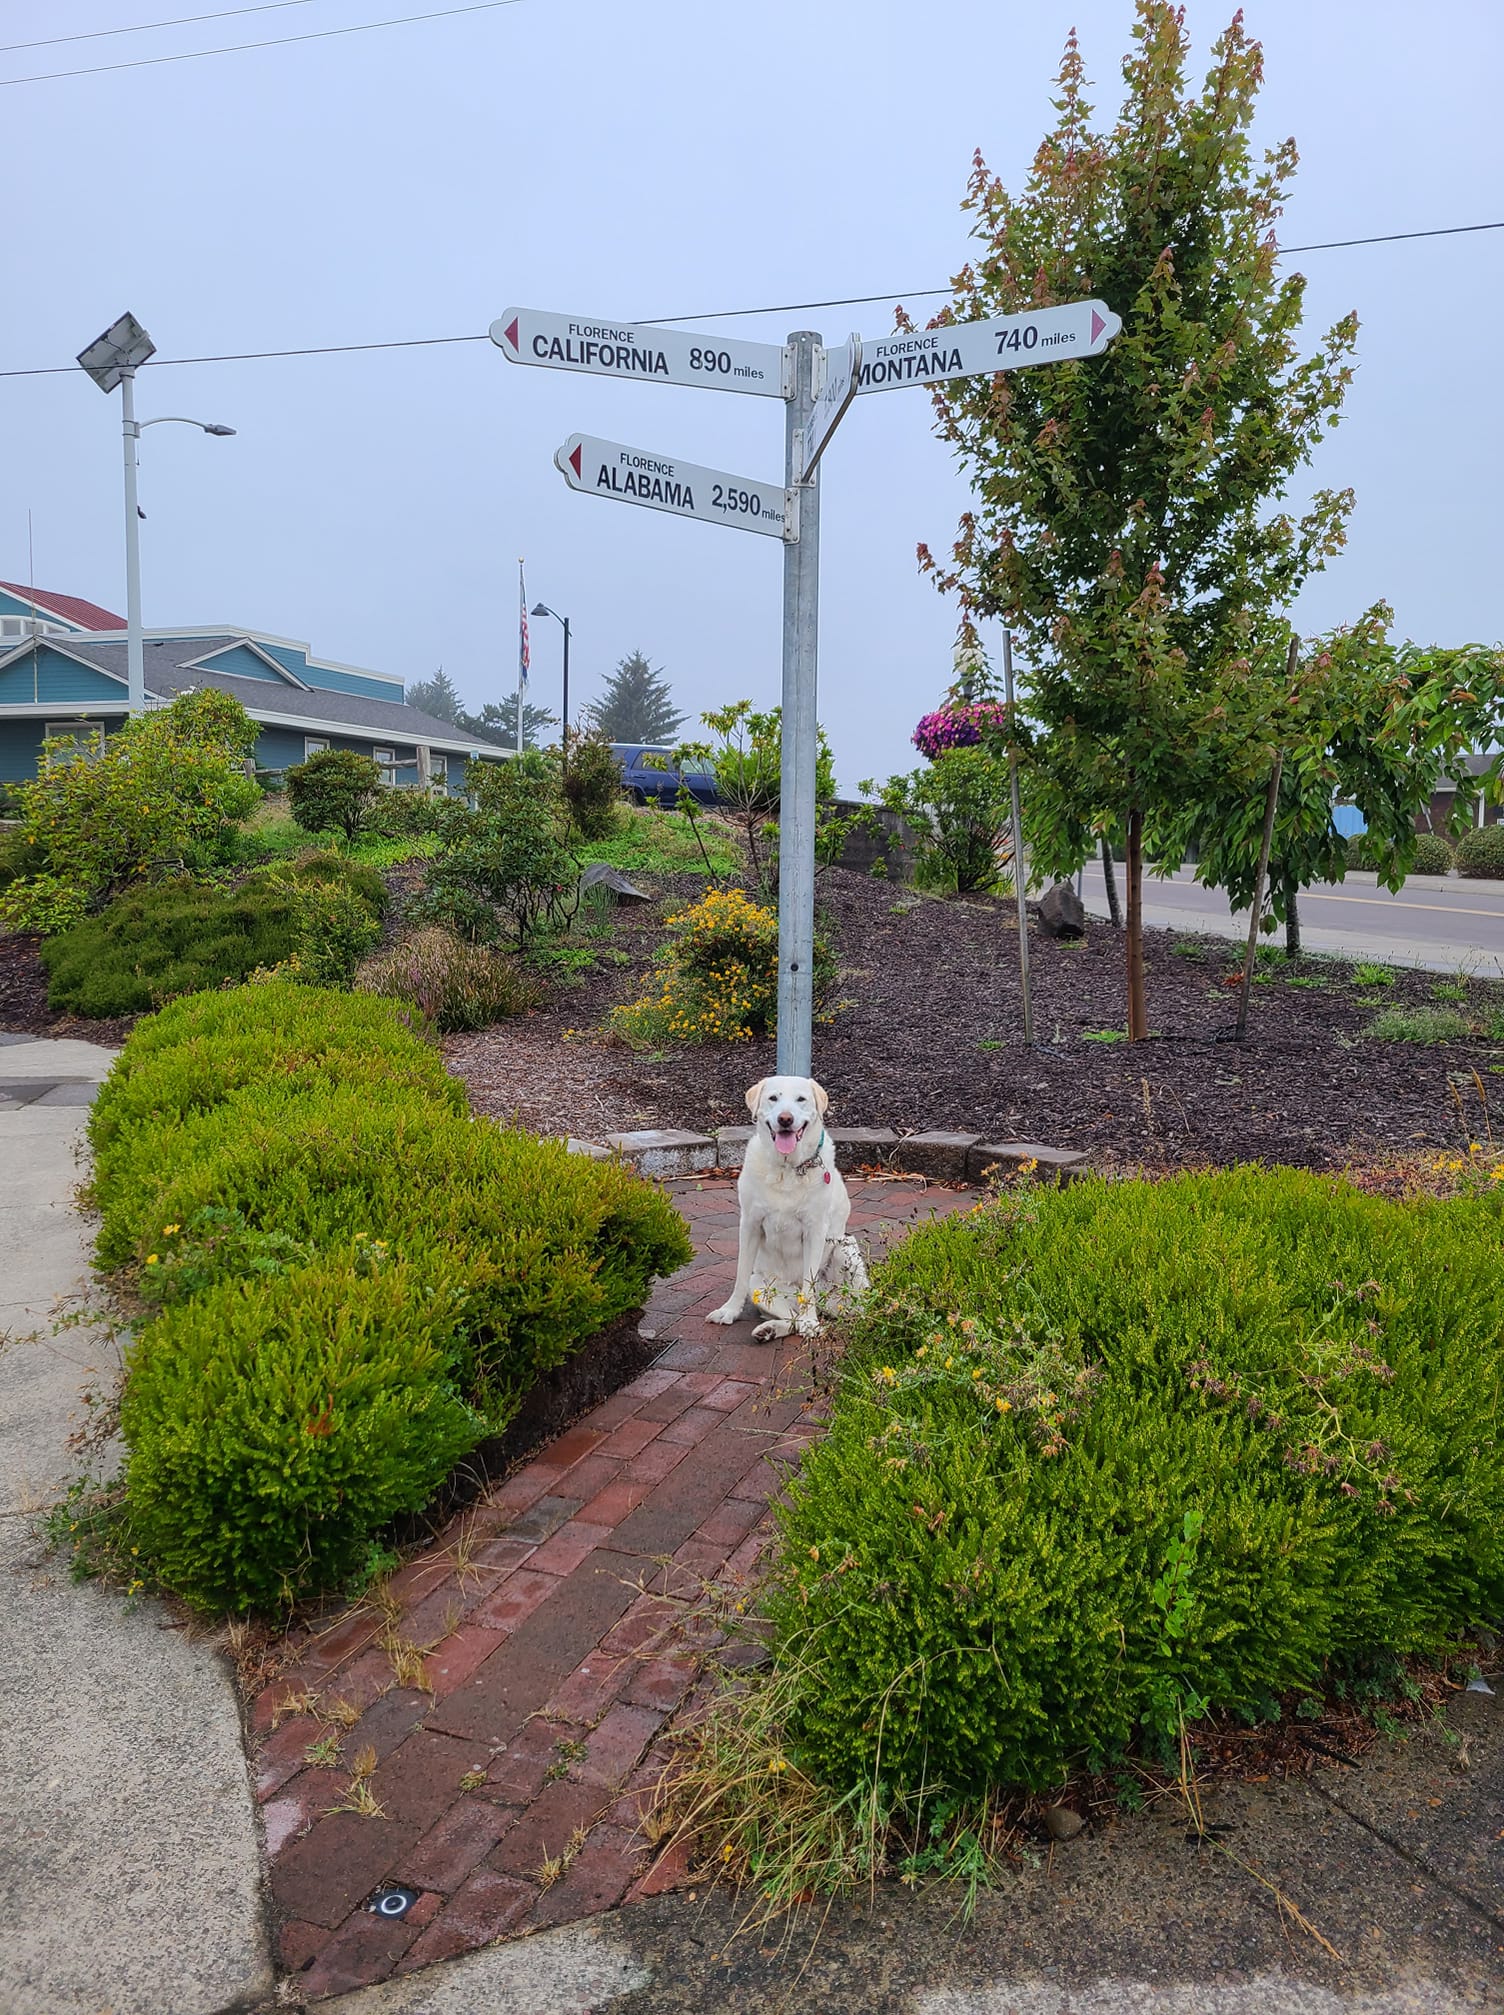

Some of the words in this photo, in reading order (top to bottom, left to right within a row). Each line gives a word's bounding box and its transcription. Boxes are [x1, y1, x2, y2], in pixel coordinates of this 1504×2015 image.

[568, 323, 635, 344] FLORENCE
[876, 336, 938, 358] FLORENCE
[994, 326, 1038, 355] 740
[1041, 332, 1076, 347] miles
[532, 335, 670, 375] CALIFORNIA
[689, 347, 732, 374] 890
[733, 365, 765, 380] miles
[620, 452, 675, 477] FLORENCE
[596, 464, 695, 509] ALABAMA
[711, 484, 761, 516] 2,590
[761, 509, 785, 523] miles
